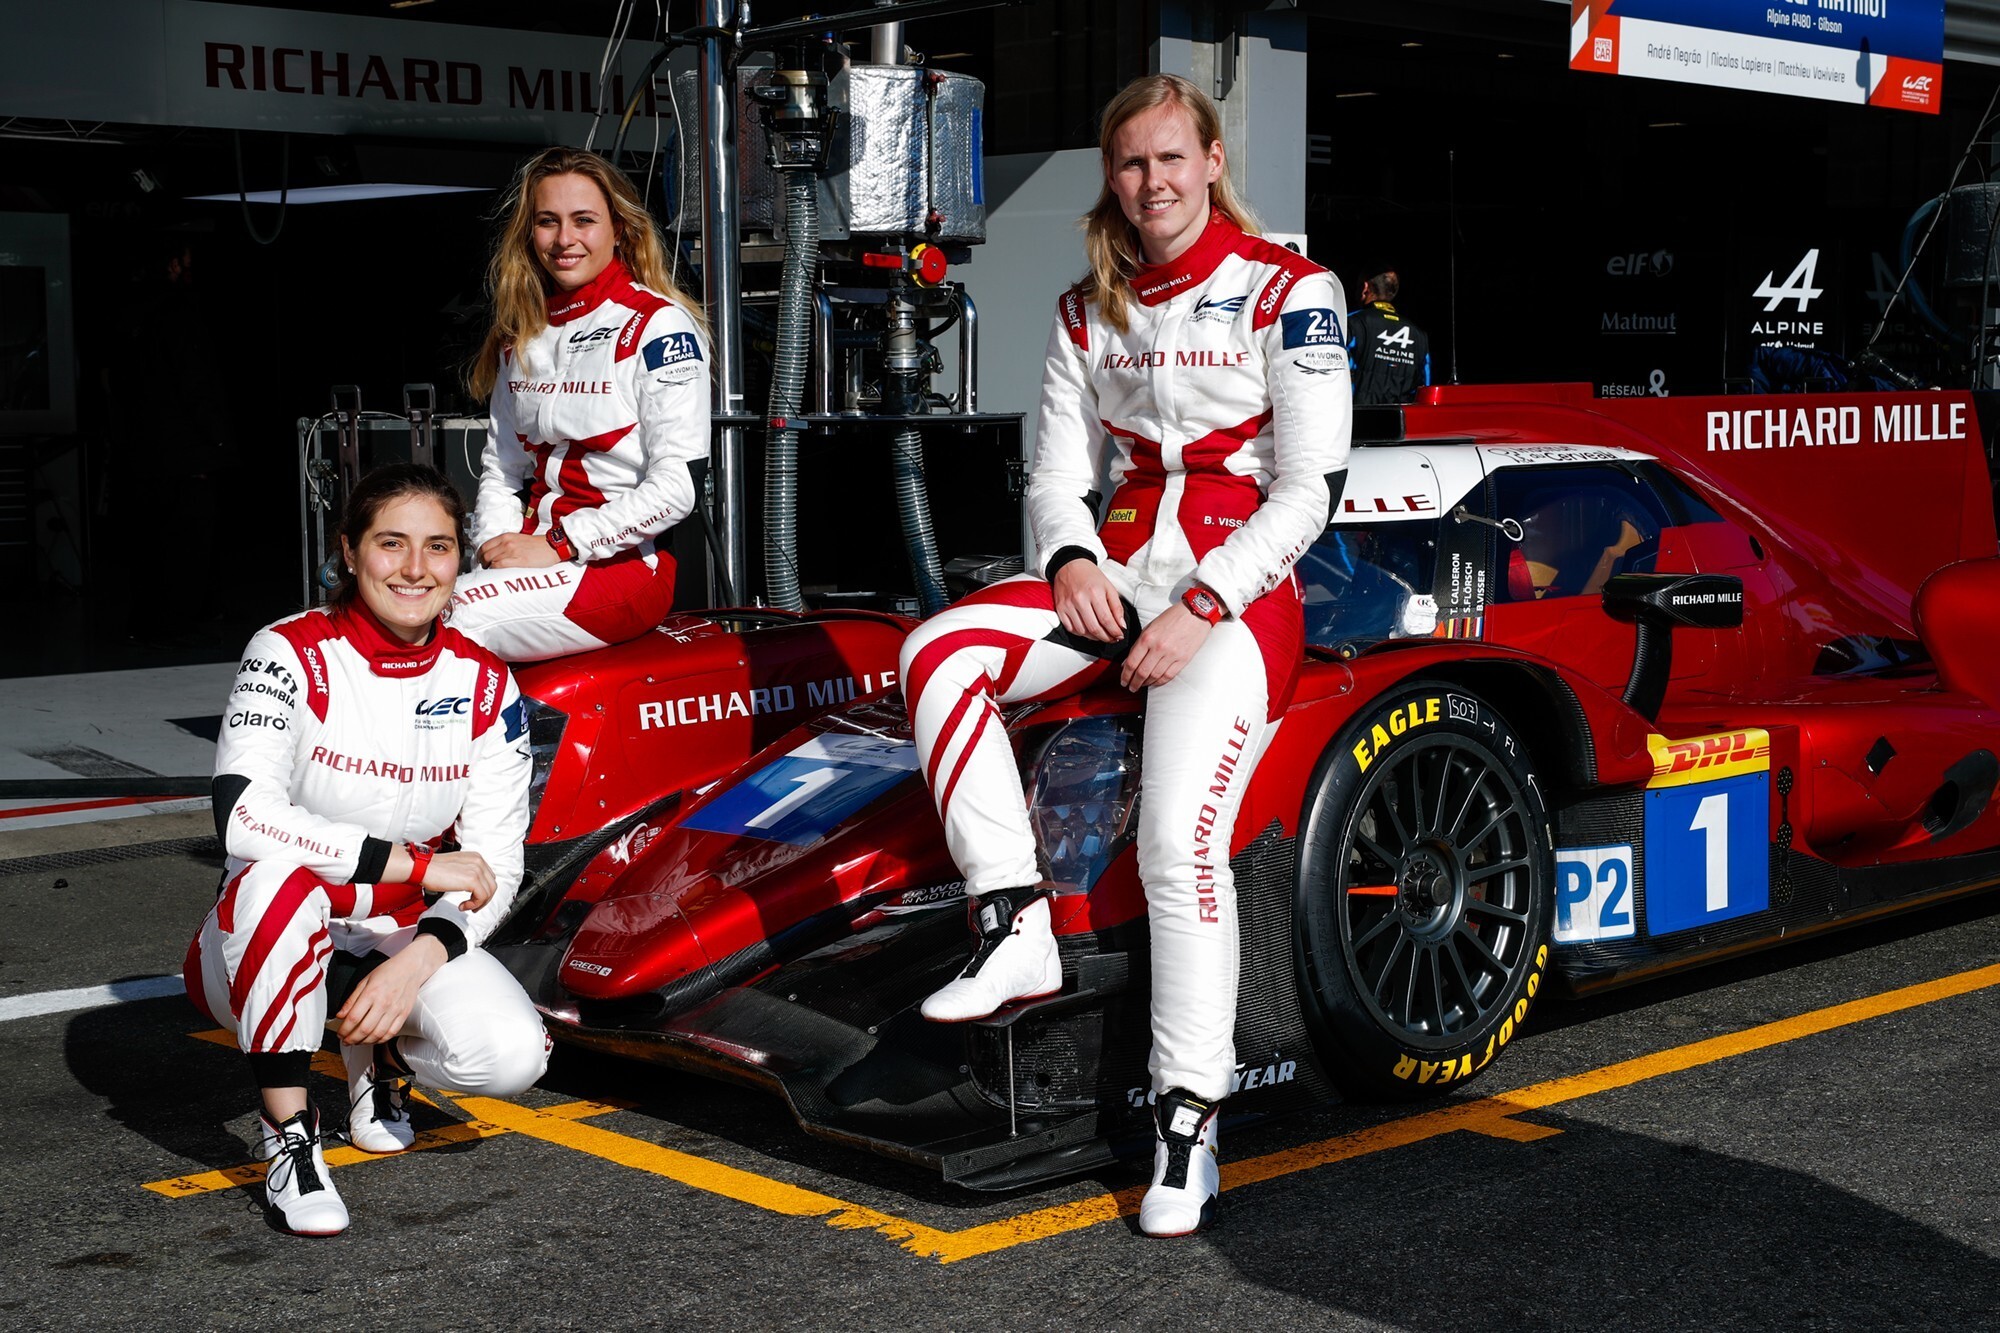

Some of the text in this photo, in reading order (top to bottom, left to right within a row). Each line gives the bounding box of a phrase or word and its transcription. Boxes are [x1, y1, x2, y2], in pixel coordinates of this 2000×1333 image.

[1766, 9, 1790, 28] Alpine
[1791, 13, 1811, 29] A480
[1818, 17, 1842, 34] Gibson
[1595, 47, 1611, 60] CAR
[1647, 43, 1671, 60] André
[1711, 51, 1739, 69] Nicolas
[1741, 56, 1772, 75] Lapierre
[1778, 61, 1811, 78] Matthieu
[204, 42, 672, 119] RICHARD MILLE
[1902, 75, 1933, 91] WEC
[1141, 273, 1192, 297] RICHARD MILLE
[1260, 268, 1294, 315] Sabelt
[1065, 292, 1082, 330] Sabelt
[1601, 312, 1677, 332] Matmut
[620, 312, 645, 348] Sabelt
[1306, 311, 1339, 336] 24h
[1751, 321, 1824, 335] ALPINE
[662, 333, 694, 358] 24h
[1305, 335, 1340, 344] LE MANS
[663, 352, 695, 364] LE MANS
[1101, 351, 1249, 370] ICHARD MILLE
[1317, 352, 1343, 361] WOMEN
[1375, 347, 1414, 359] ALPINE
[508, 381, 612, 394] RCHARD MILLE
[1601, 382, 1645, 396] RÉSEAU
[1707, 403, 1967, 451] RICHARD MILLE
[1109, 509, 1133, 522] Sabelt
[1344, 494, 1436, 513] LLE
[590, 505, 674, 550] RICHARD MILLE
[1204, 515, 1246, 529] B. VISS
[504, 570, 572, 593] MILLE
[1450, 553, 1460, 615] T. CALDERON
[1672, 592, 1742, 606] RICHARD MILLE
[303, 646, 328, 695] Sabelt
[382, 661, 417, 669] RICHARD
[234, 682, 295, 710] COLOMBIA
[479, 667, 500, 716] Sabelt
[415, 697, 471, 716] WEC
[638, 684, 794, 730] RICHARD
[229, 710, 287, 731] Claro
[1352, 698, 1440, 773] EAGLE
[1504, 735, 1516, 757] FL
[311, 746, 470, 784] RICHARD MILLE
[1668, 733, 1756, 773] DHL
[744, 767, 853, 829] 1
[1193, 715, 1251, 924] RICHARD MILLE
[294, 836, 345, 859] MILLE
[1689, 793, 1728, 912] 1
[901, 897, 913, 905] IN
[1556, 858, 1630, 932] P2
[1392, 944, 1548, 1085] GOODYEAR
